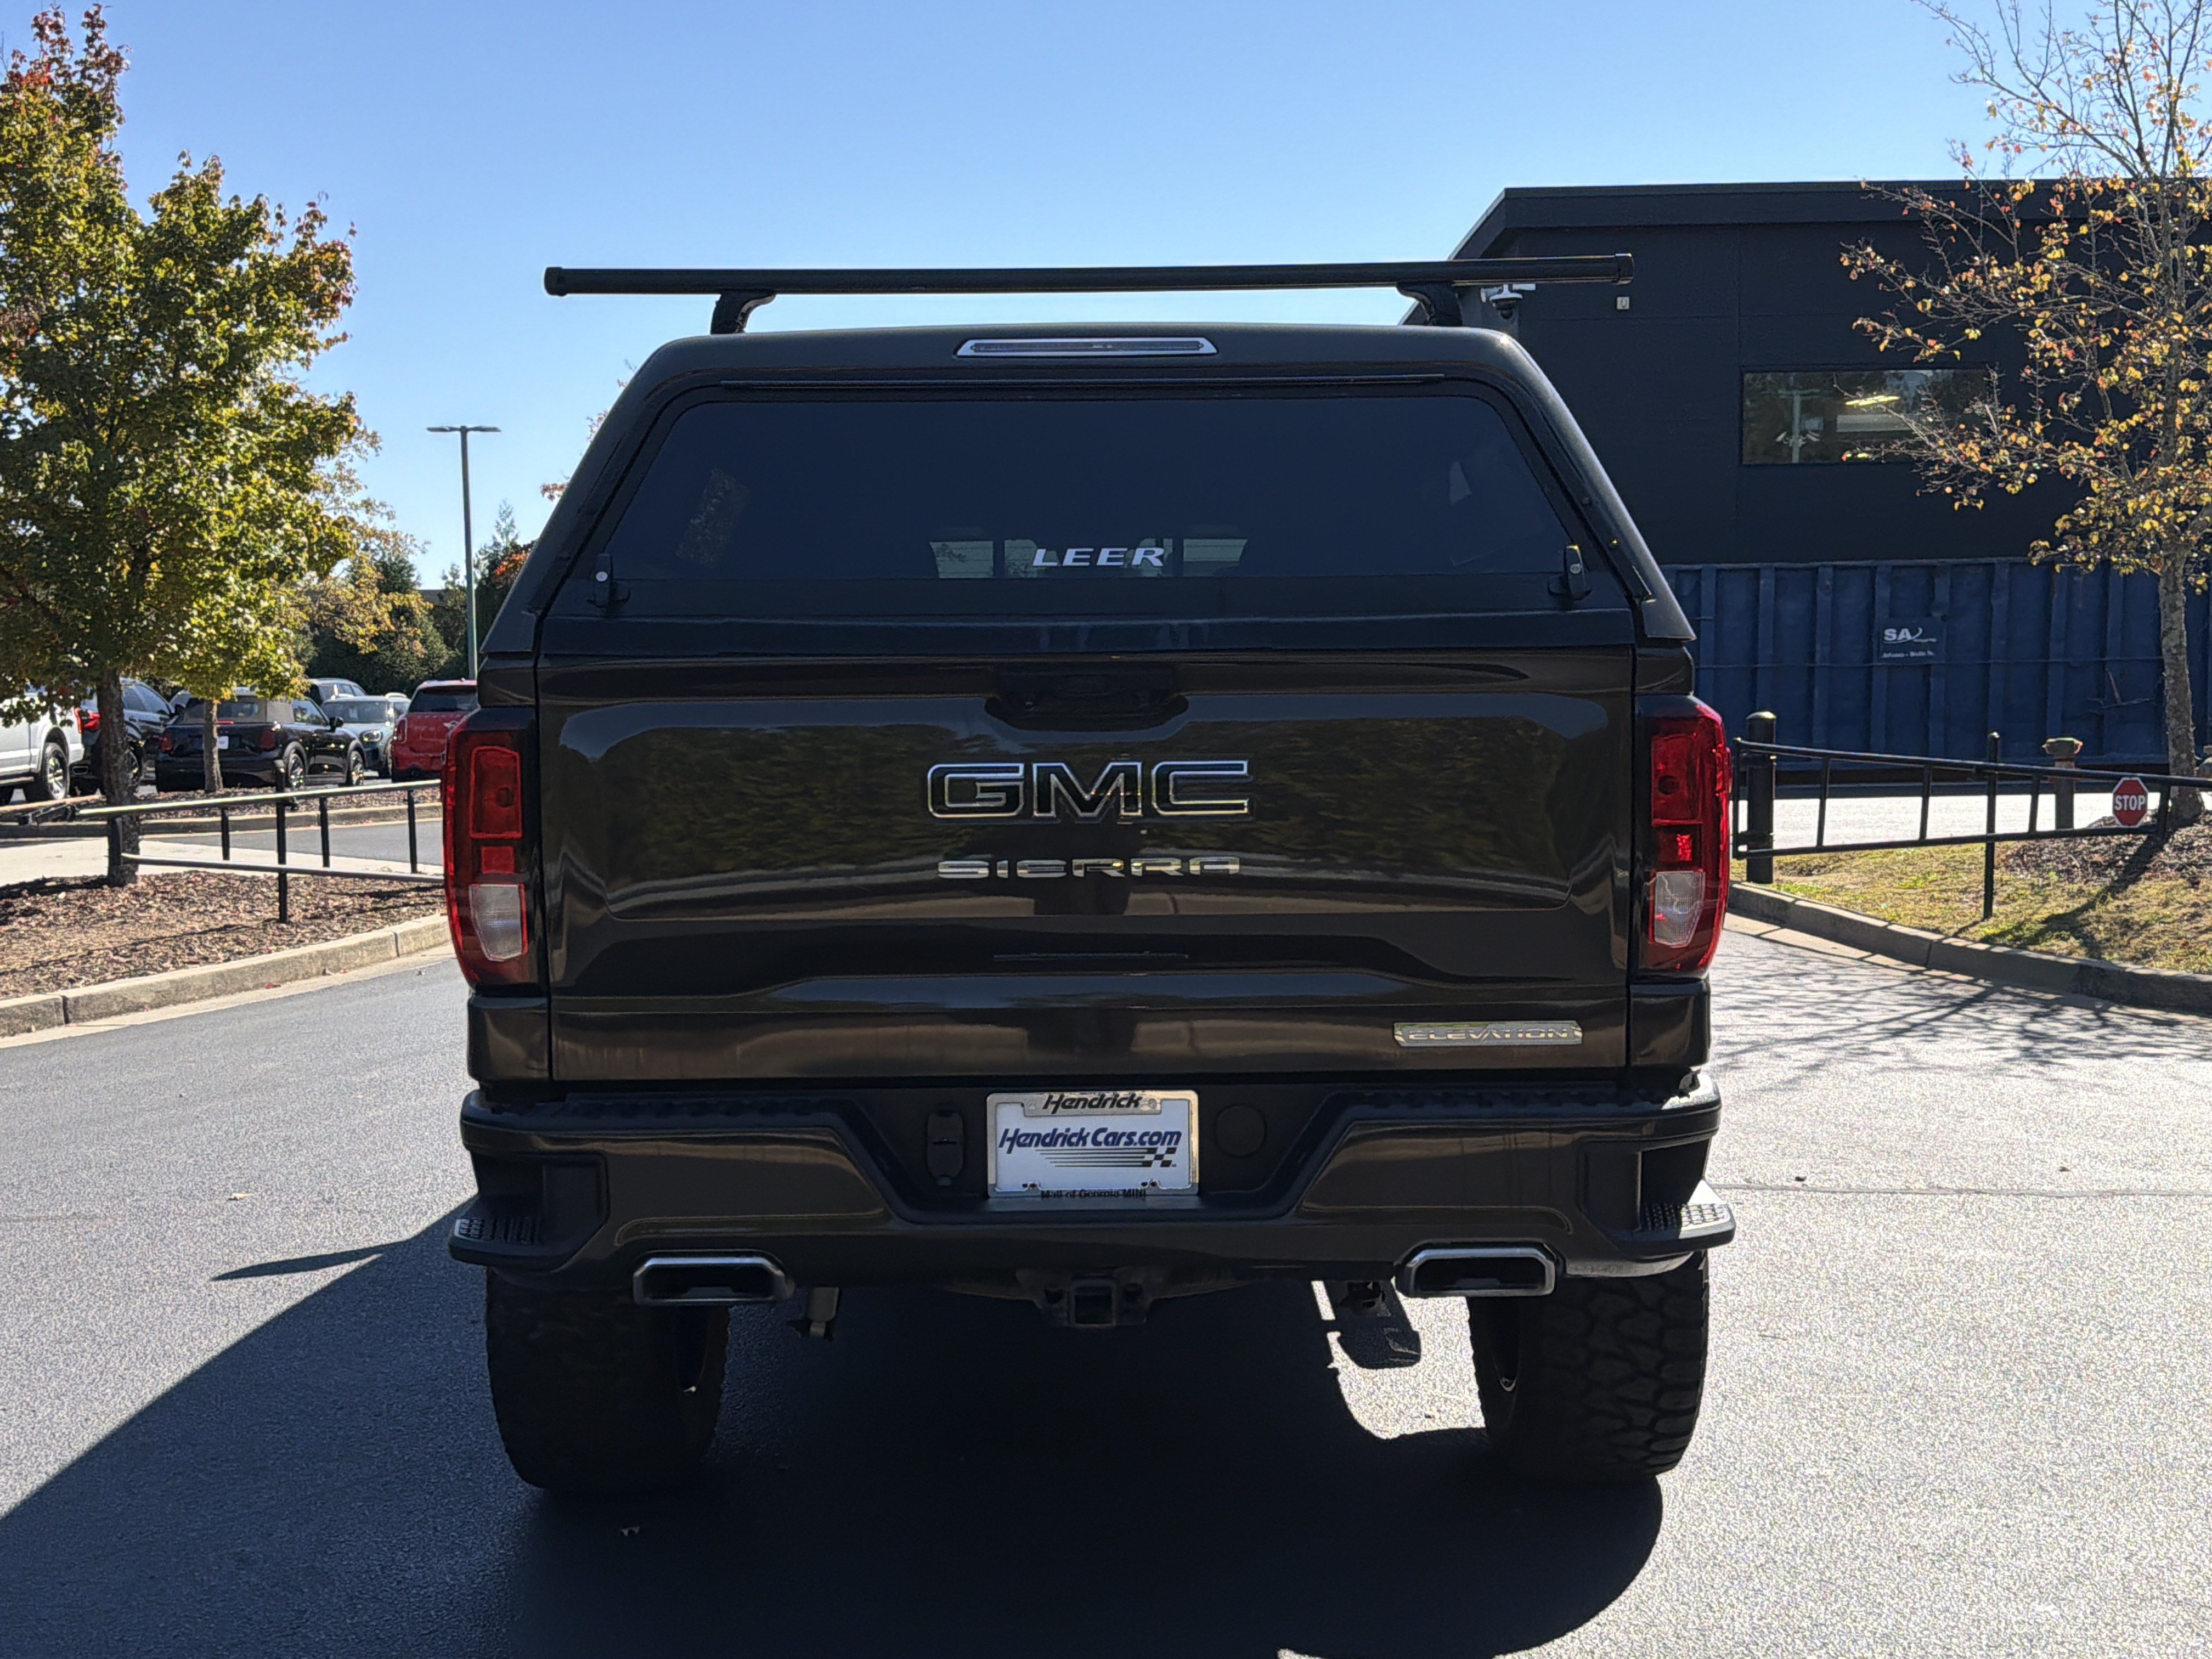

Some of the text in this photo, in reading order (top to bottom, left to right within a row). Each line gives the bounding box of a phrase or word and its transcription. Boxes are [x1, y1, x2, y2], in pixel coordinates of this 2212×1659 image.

[1032, 547, 1165, 567] LEER
[927, 760, 1249, 818] GMC
[2114, 794, 2146, 811] STOP
[938, 856, 1240, 878] SIERRA
[1408, 1028, 1568, 1041] ELEVATION
[1042, 1093, 1143, 1114] Hendrick
[1122, 1188, 1147, 1197] MINI
